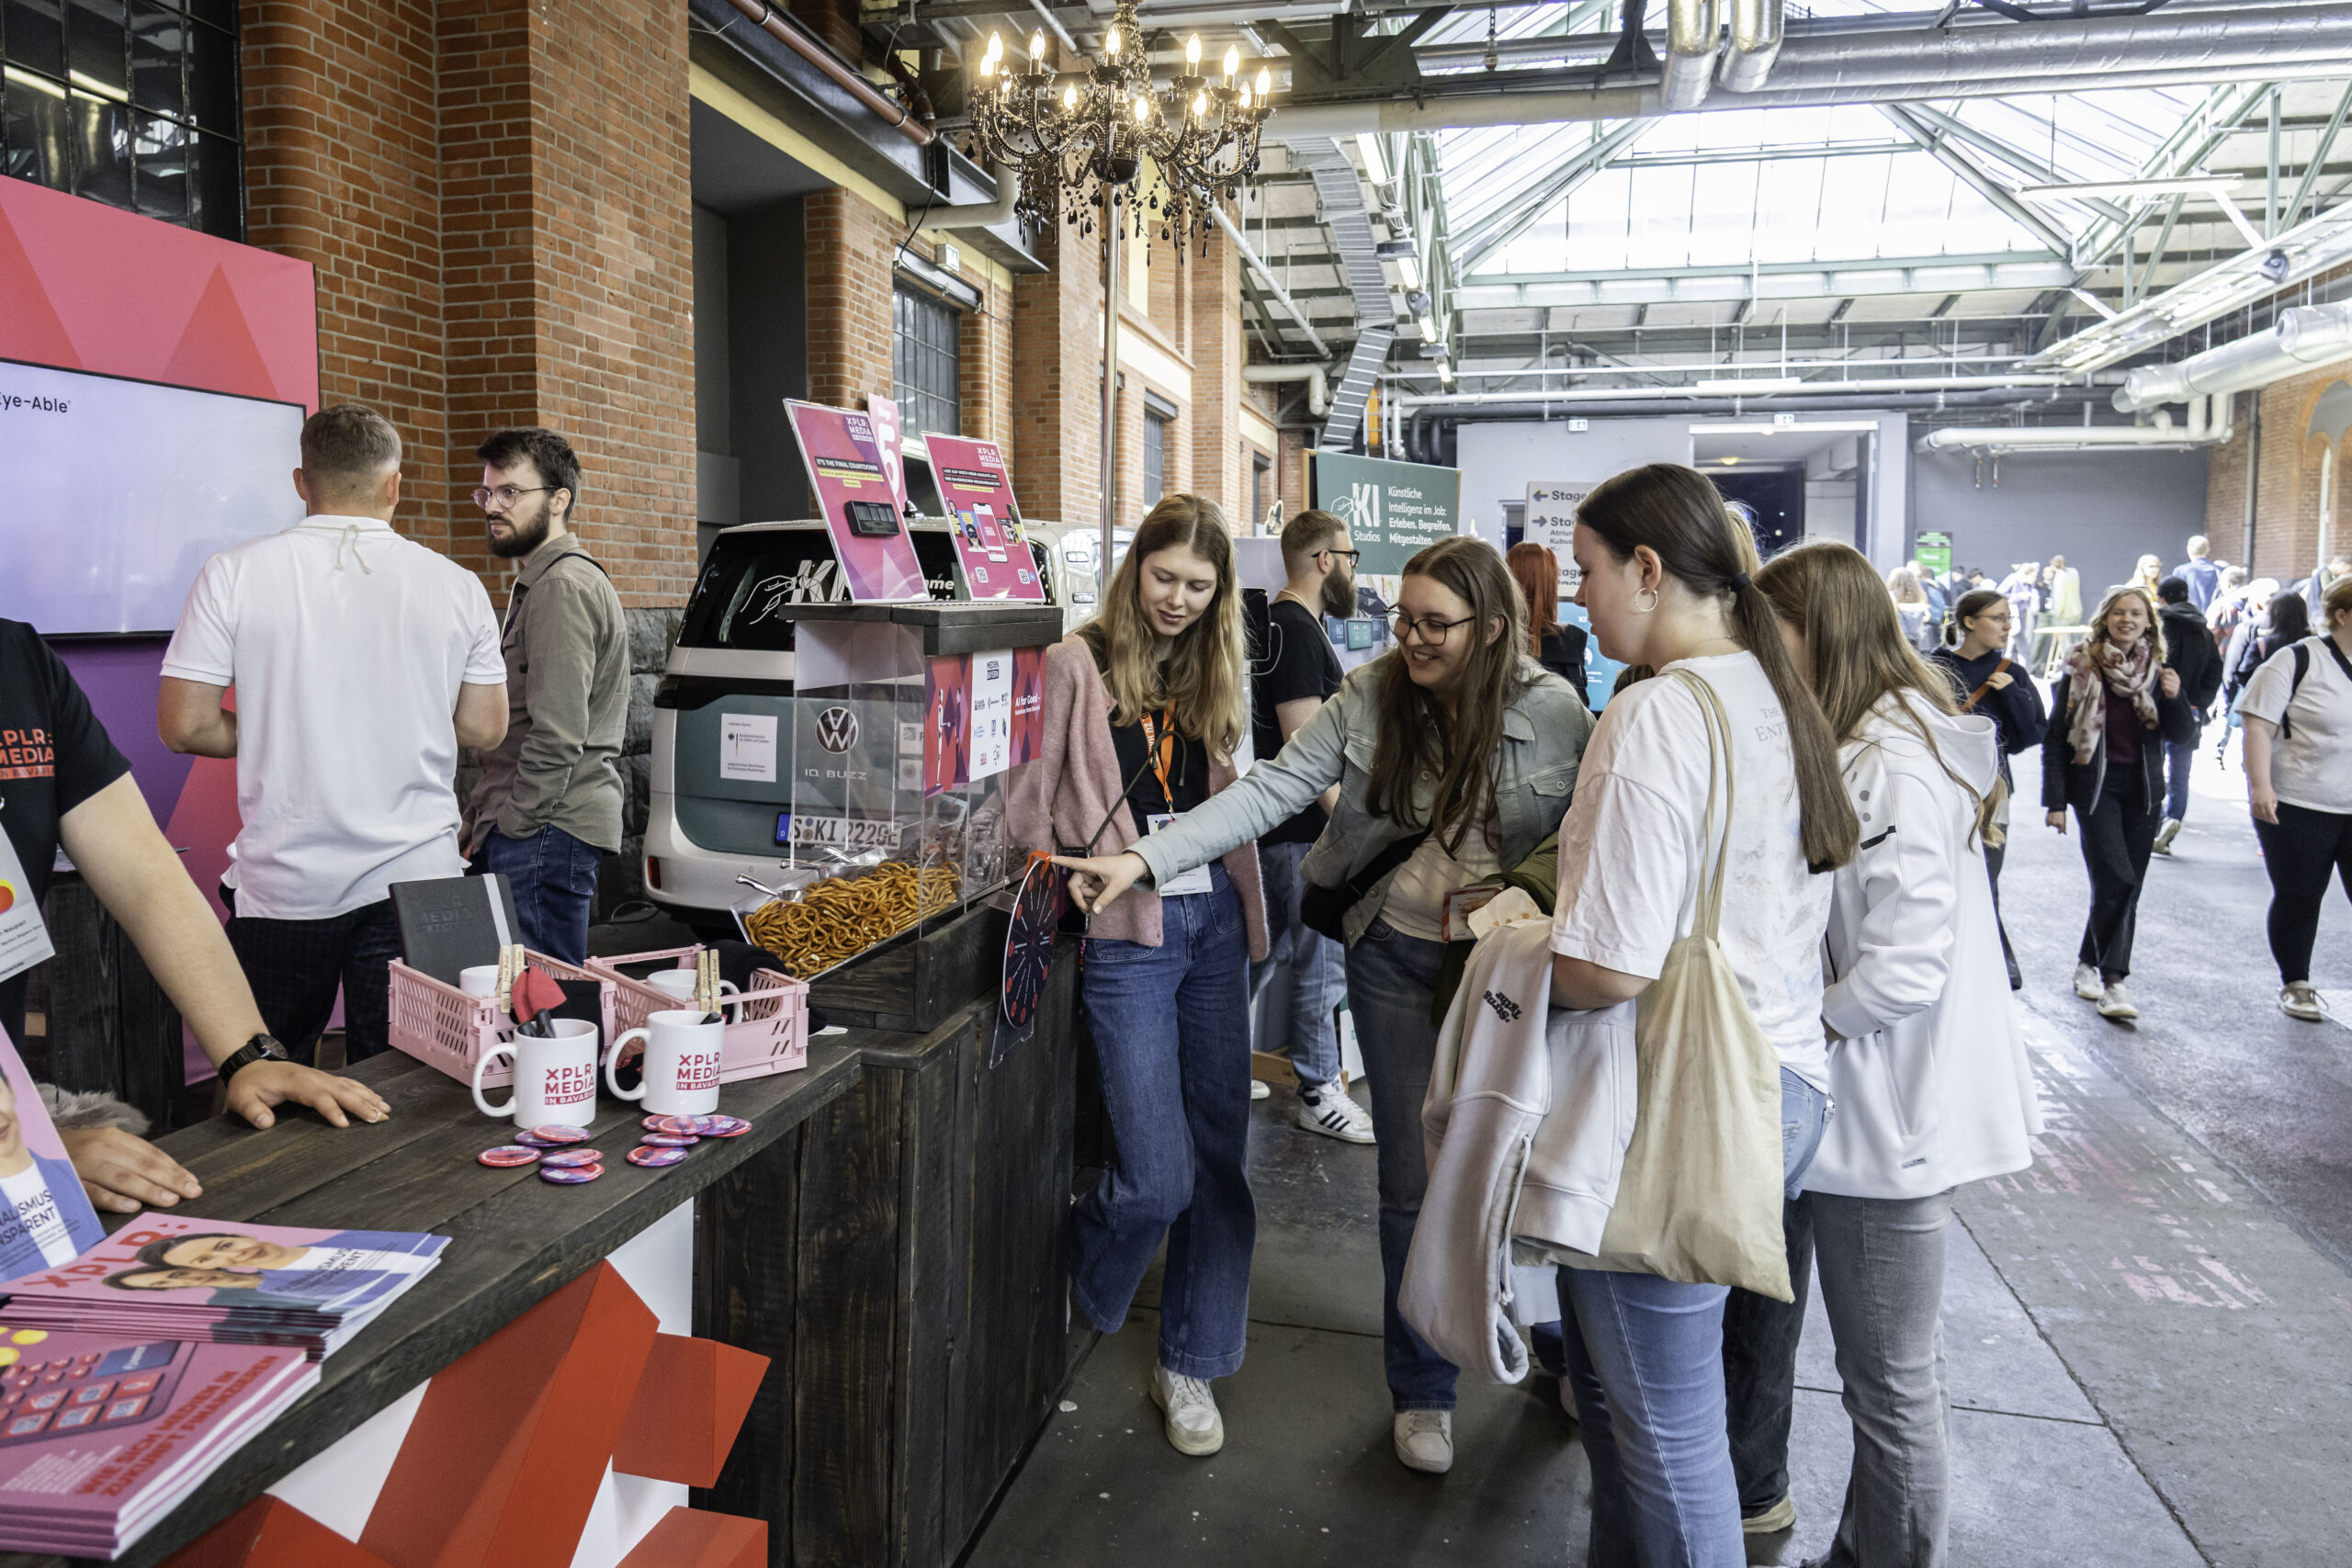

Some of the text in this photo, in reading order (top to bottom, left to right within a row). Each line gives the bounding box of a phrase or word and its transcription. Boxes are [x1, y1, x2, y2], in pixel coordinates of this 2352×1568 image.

[849, 426, 872, 436] MEDIA
[978, 455, 1001, 464] MEDIA
[1387, 486, 1422, 499] Künstliche
[1552, 491, 1588, 502] Stage
[1352, 482, 1380, 527] KI
[1388, 502, 1447, 516] Intelligenz im Job:
[1388, 517, 1452, 533] Erleben. Begreifen.
[1353, 530, 1381, 542] Studios
[1389, 533, 1434, 547] Mitgestalten.
[1558, 569, 1581, 579] tage
[1026, 693, 1038, 705] Good
[0, 728, 53, 747] PLR:
[827, 769, 868, 781] BUZZ
[791, 818, 802, 840] S
[676, 1064, 720, 1080] MEDIA
[545, 1076, 594, 1095] MEDIA
[677, 1082, 687, 1090] IN
[22, 1223, 189, 1289] XPLR:
